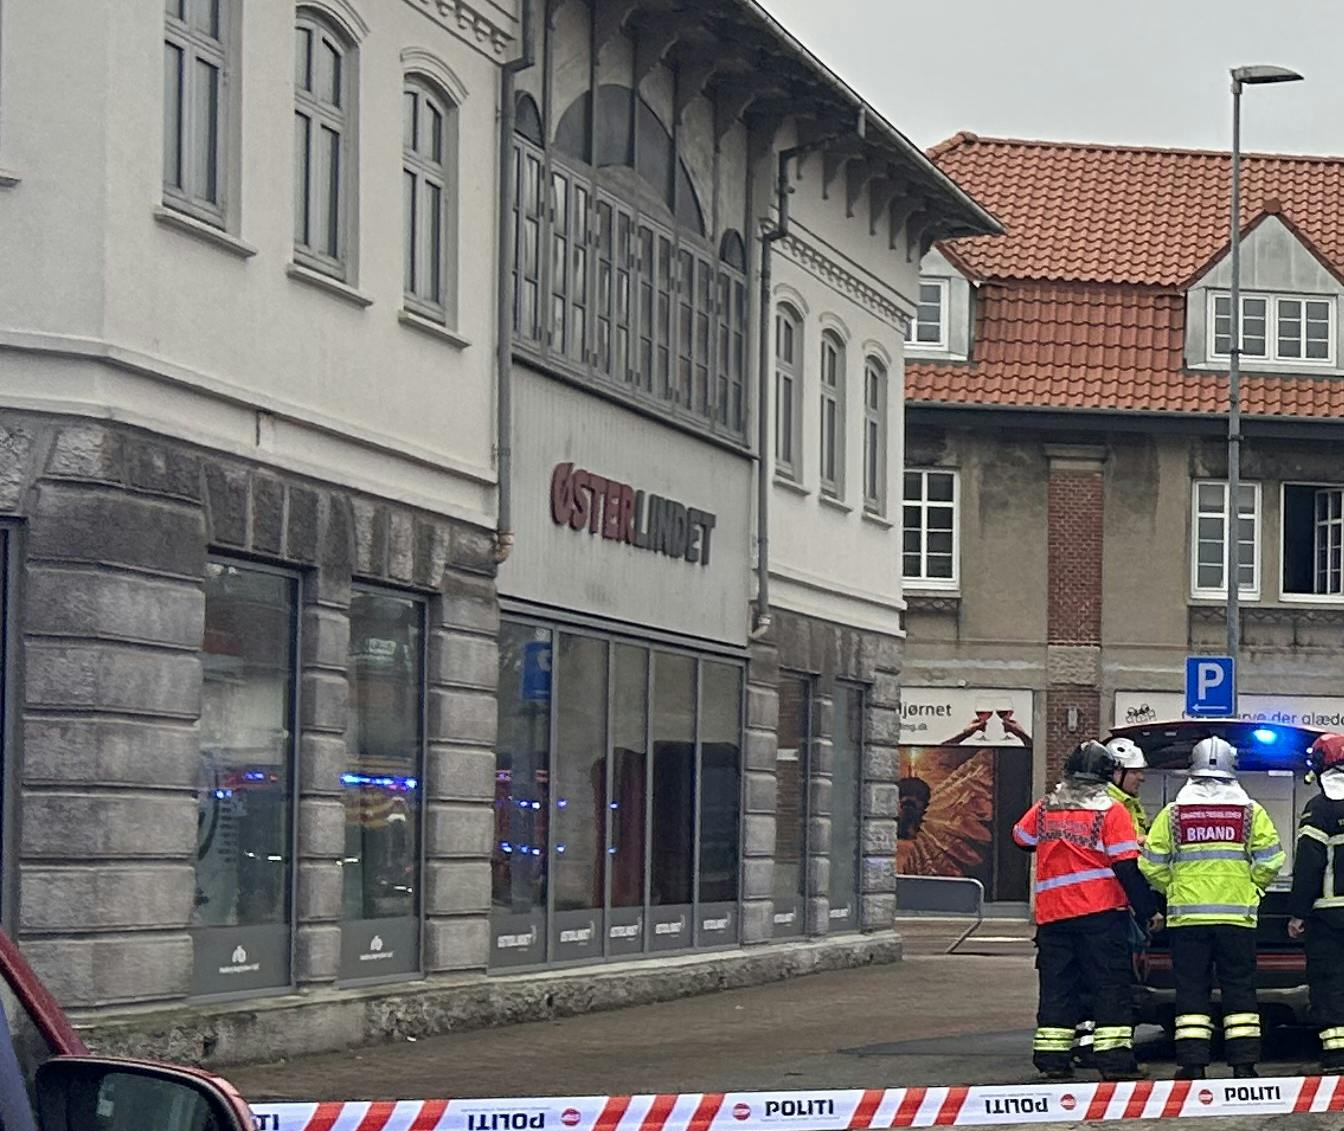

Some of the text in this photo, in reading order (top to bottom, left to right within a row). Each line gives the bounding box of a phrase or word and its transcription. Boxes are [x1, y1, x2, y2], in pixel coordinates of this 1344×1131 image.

[551, 462, 717, 567] ØSTERLINDET
[1198, 662, 1225, 700] P
[1271, 711, 1298, 724] der
[1187, 826, 1235, 841] BRAND
[1224, 1085, 1281, 1101] POLITI
[765, 1099, 834, 1117] POLITI
[985, 1097, 1049, 1114] POLITI
[468, 1112, 545, 1131] POLITI
